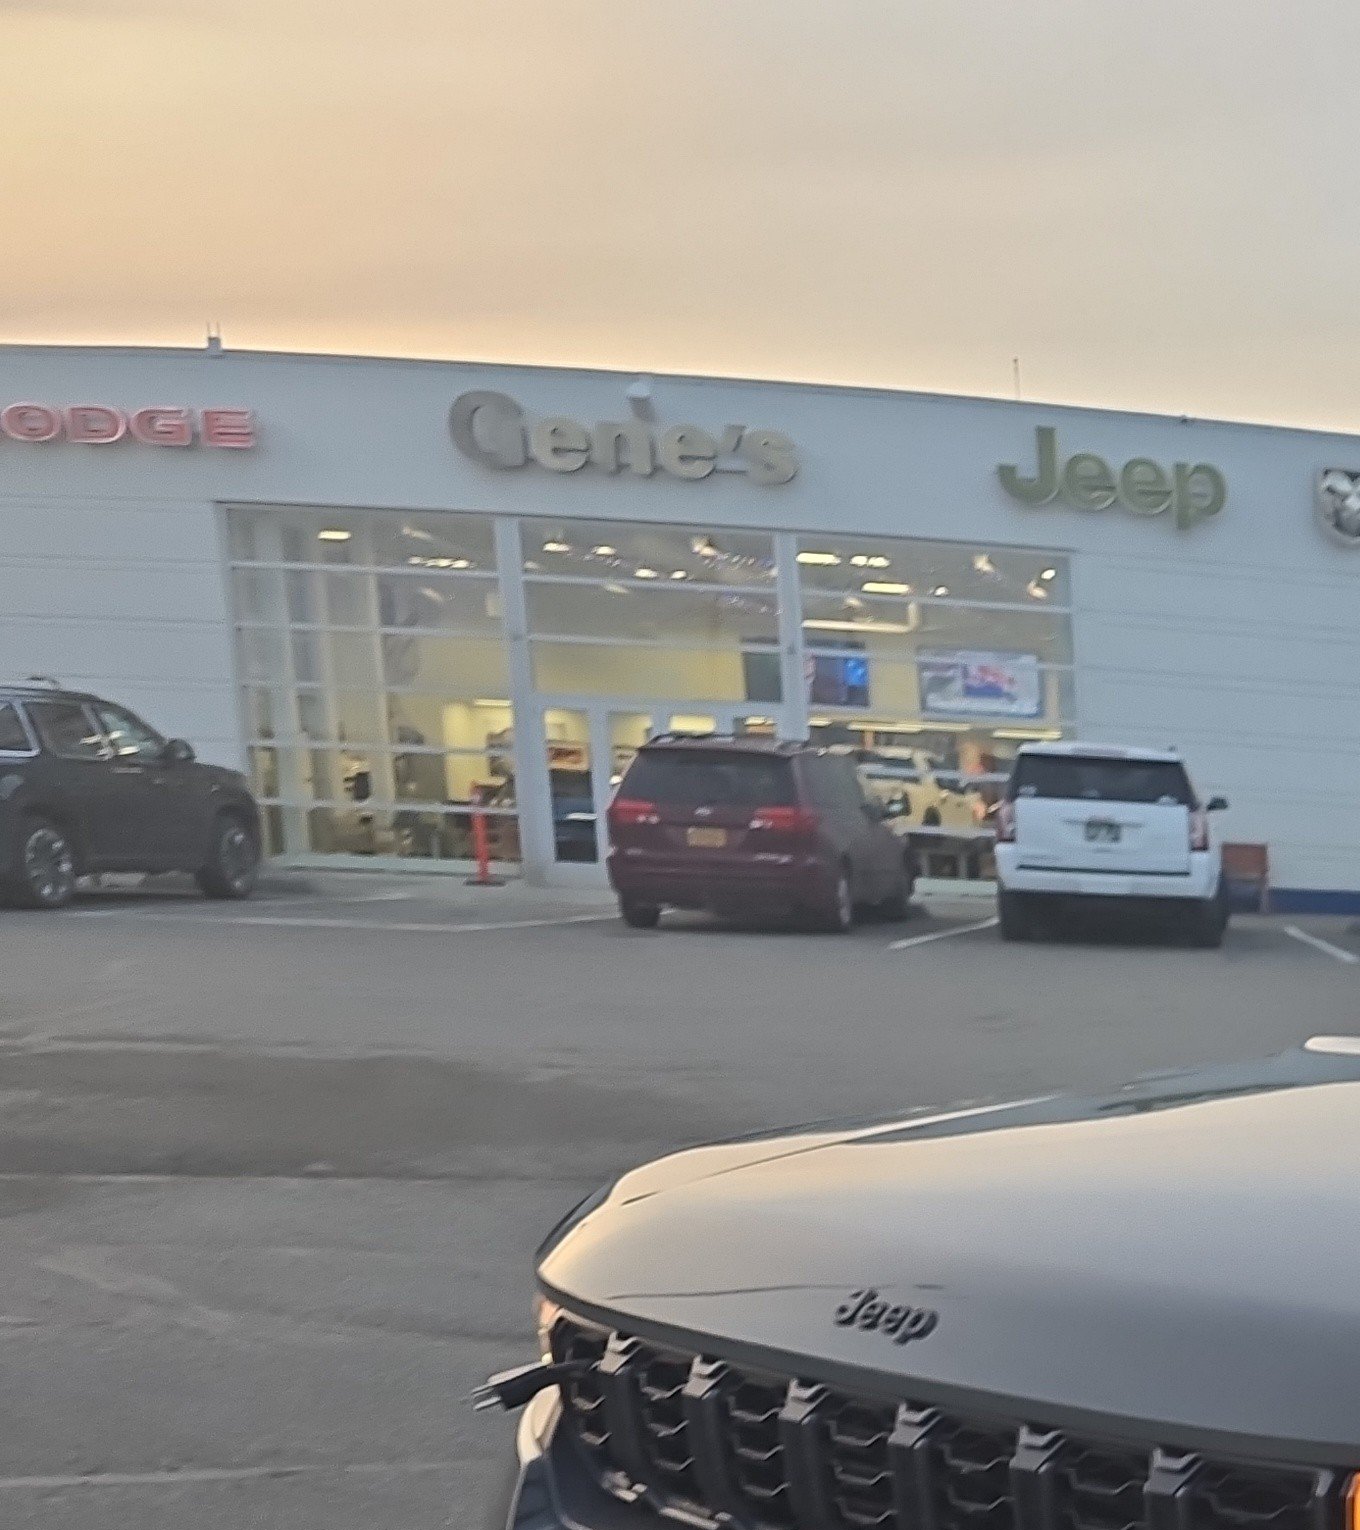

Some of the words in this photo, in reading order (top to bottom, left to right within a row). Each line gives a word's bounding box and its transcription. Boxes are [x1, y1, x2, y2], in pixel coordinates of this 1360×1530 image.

[0, 401, 257, 448] ODGE
[996, 425, 1227, 530] Jeep
[833, 1287, 940, 1345] Jeep
